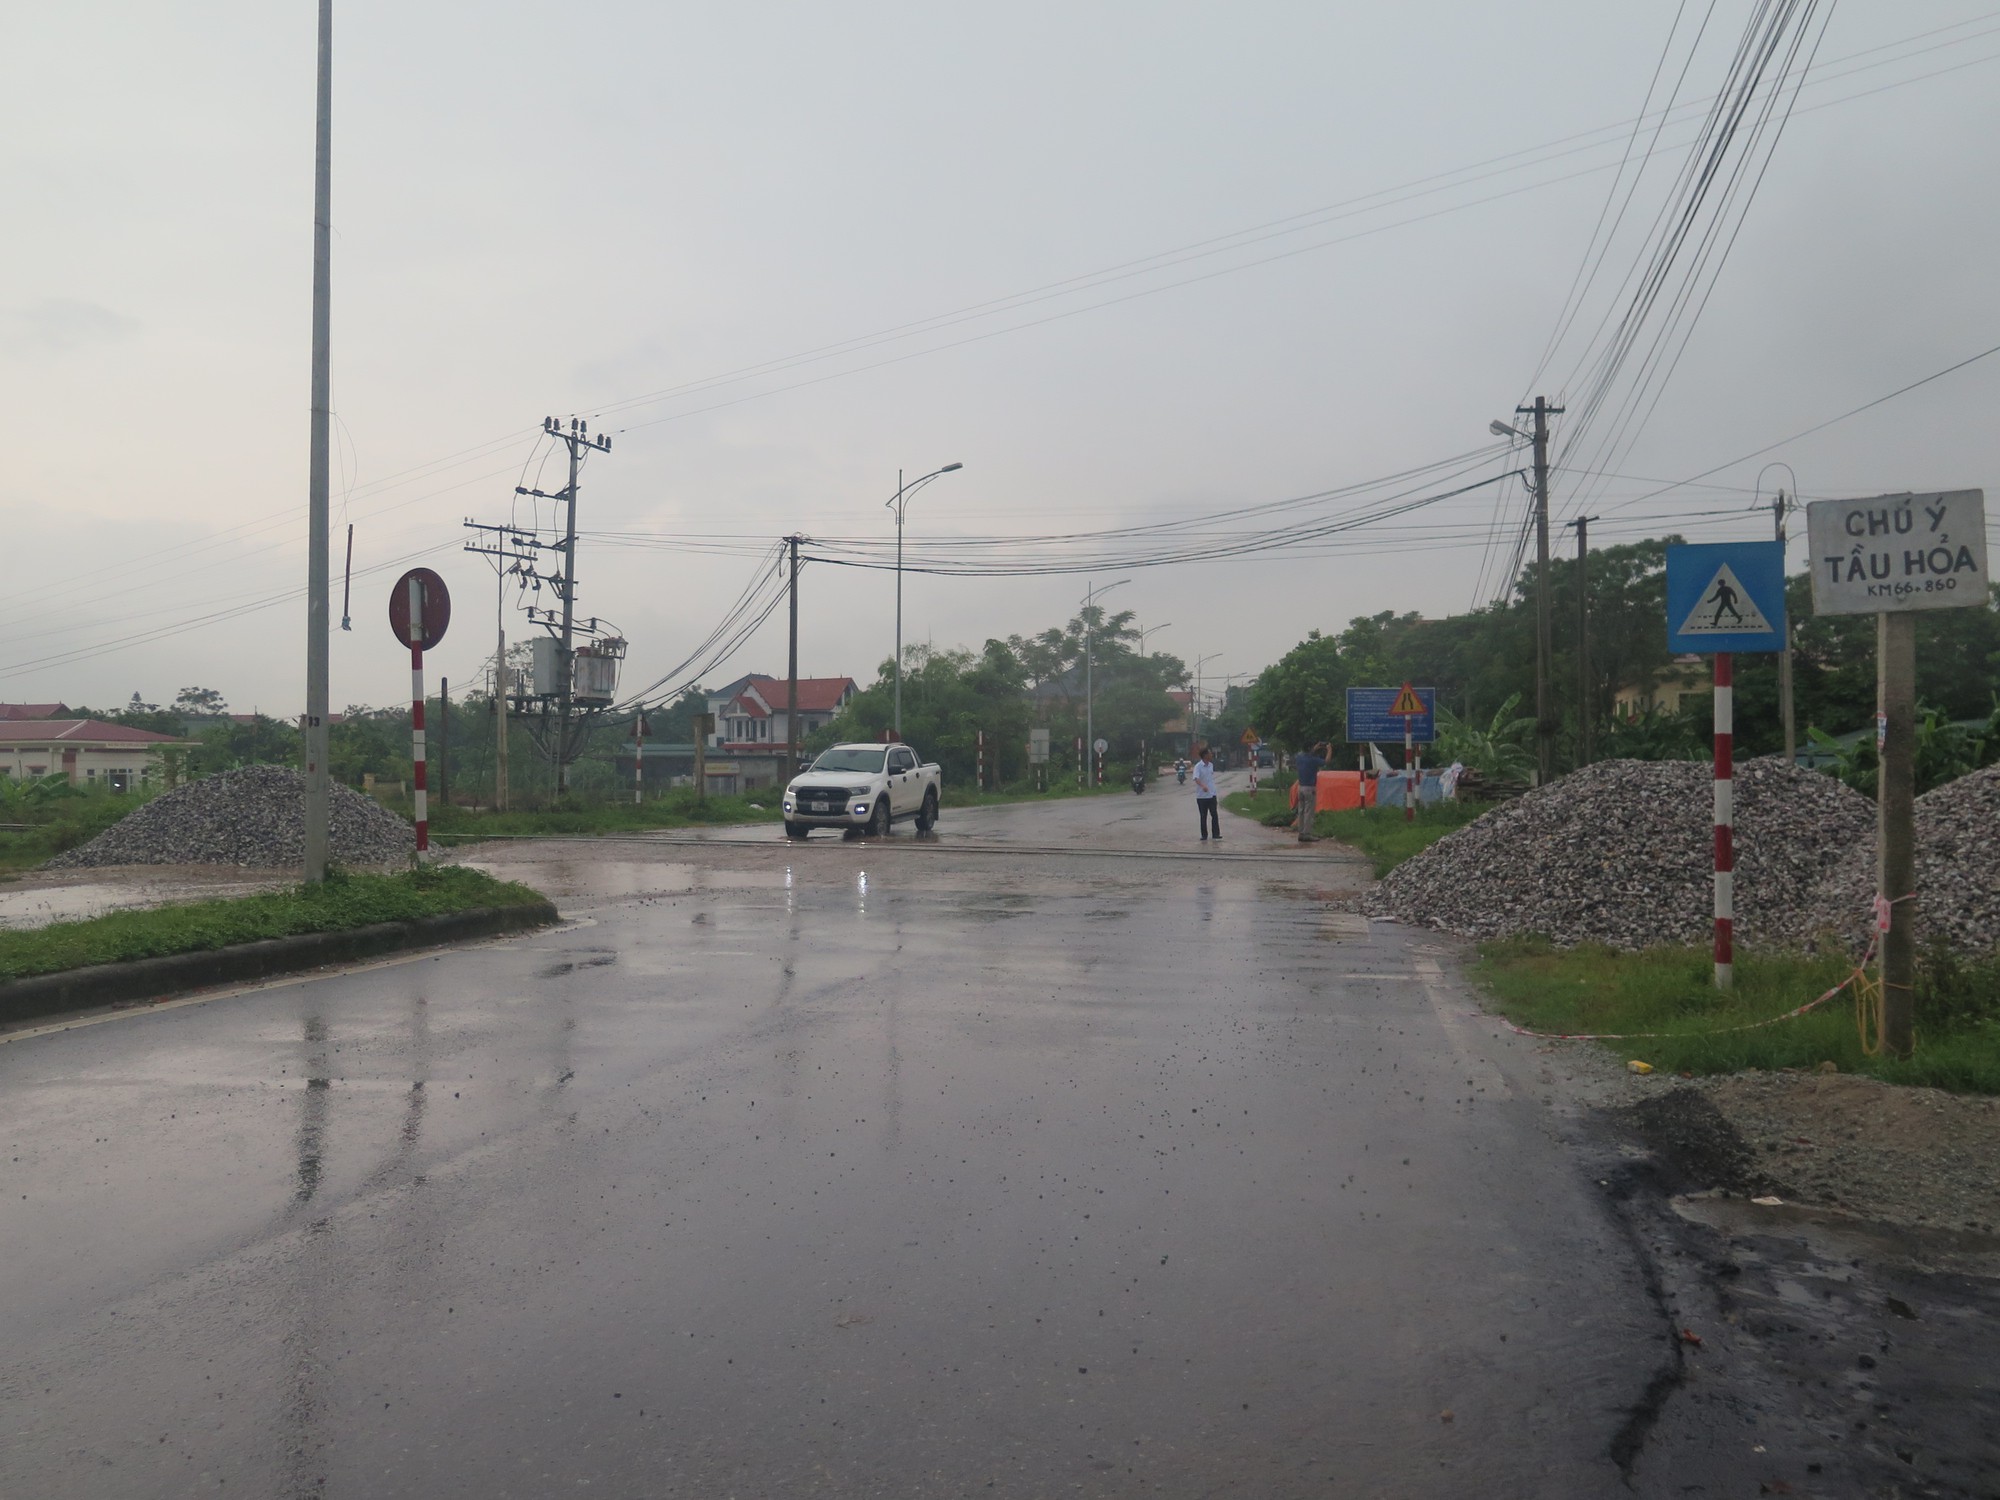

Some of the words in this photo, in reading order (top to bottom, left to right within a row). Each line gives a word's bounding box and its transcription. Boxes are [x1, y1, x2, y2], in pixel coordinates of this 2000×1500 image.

[1845, 498, 1912, 536] CHÚ
[1925, 497, 1946, 532] Ý
[1824, 544, 1890, 583] TẦU
[1904, 534, 1977, 575] HỎA
